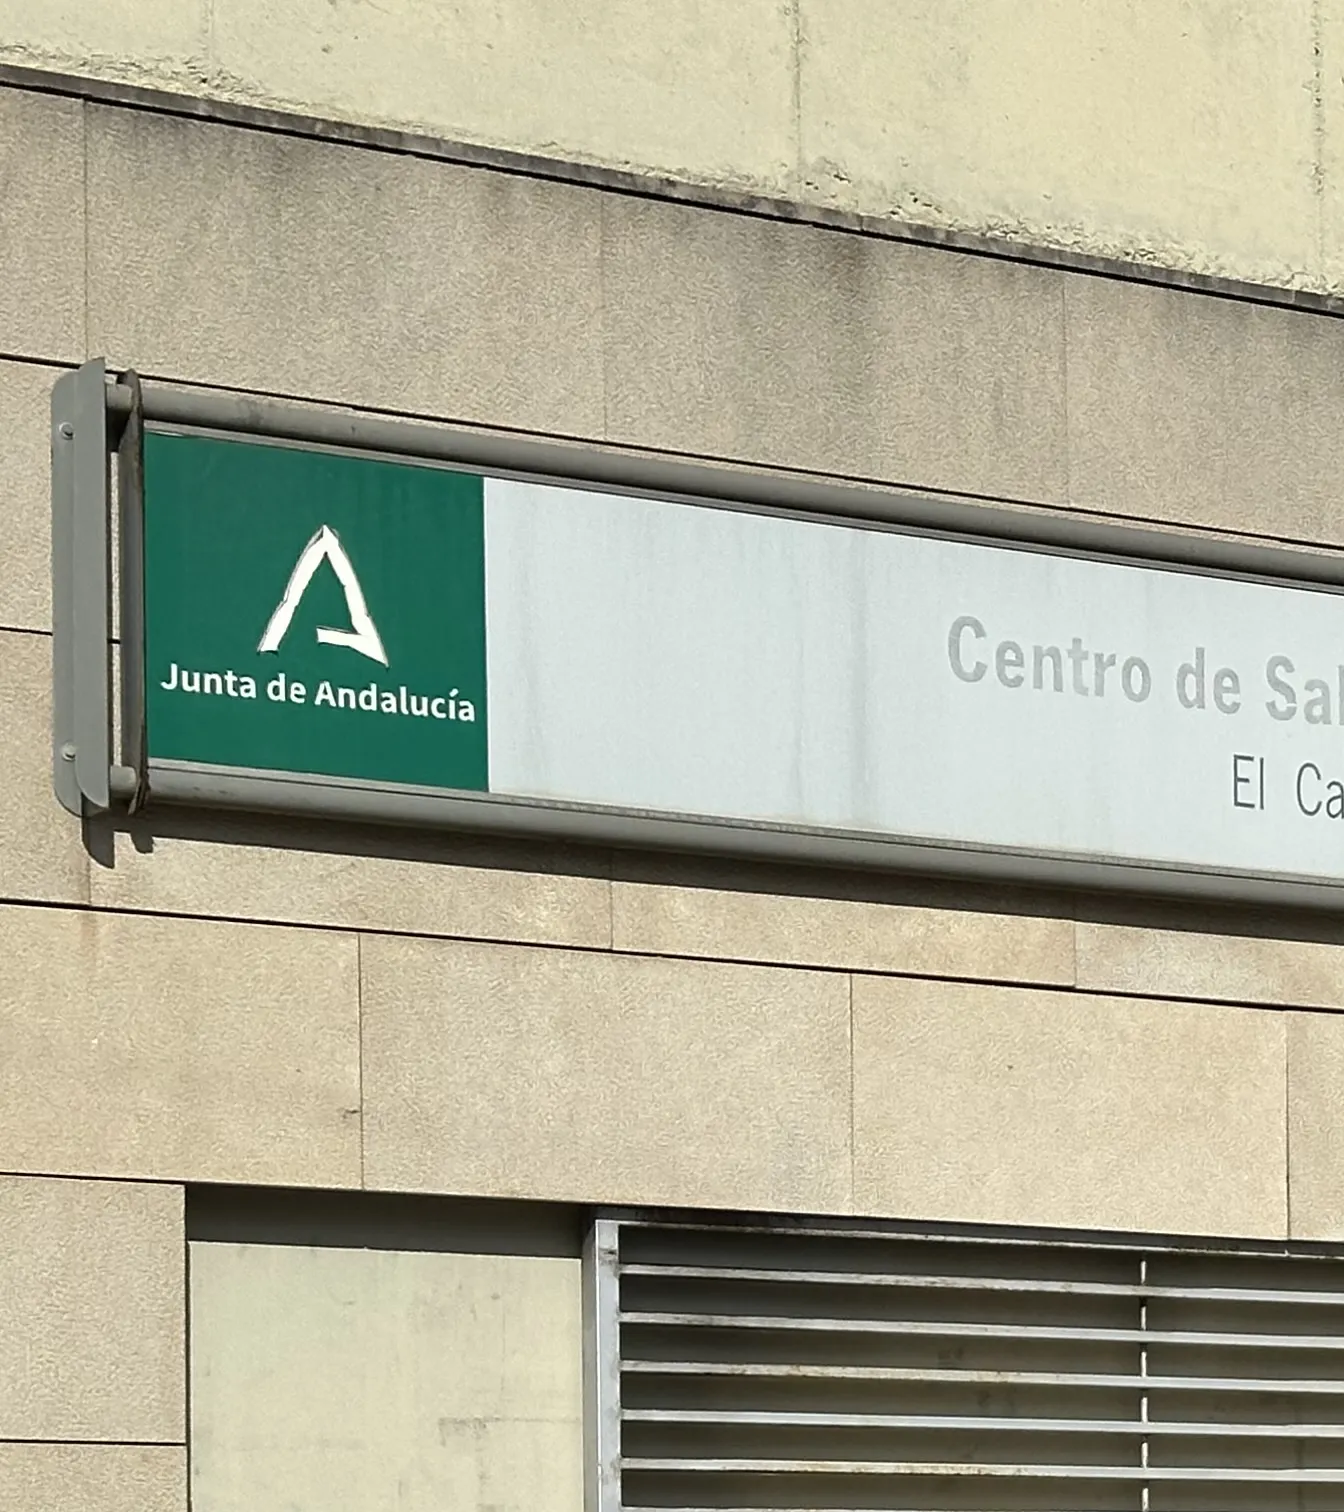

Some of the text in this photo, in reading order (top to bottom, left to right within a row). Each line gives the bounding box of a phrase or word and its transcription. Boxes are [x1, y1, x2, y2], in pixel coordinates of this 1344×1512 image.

[160, 662, 476, 722] Junta de Andalucía
[946, 615, 1152, 704] Centro
[1176, 646, 1242, 716] de
[1232, 753, 1265, 811] El
